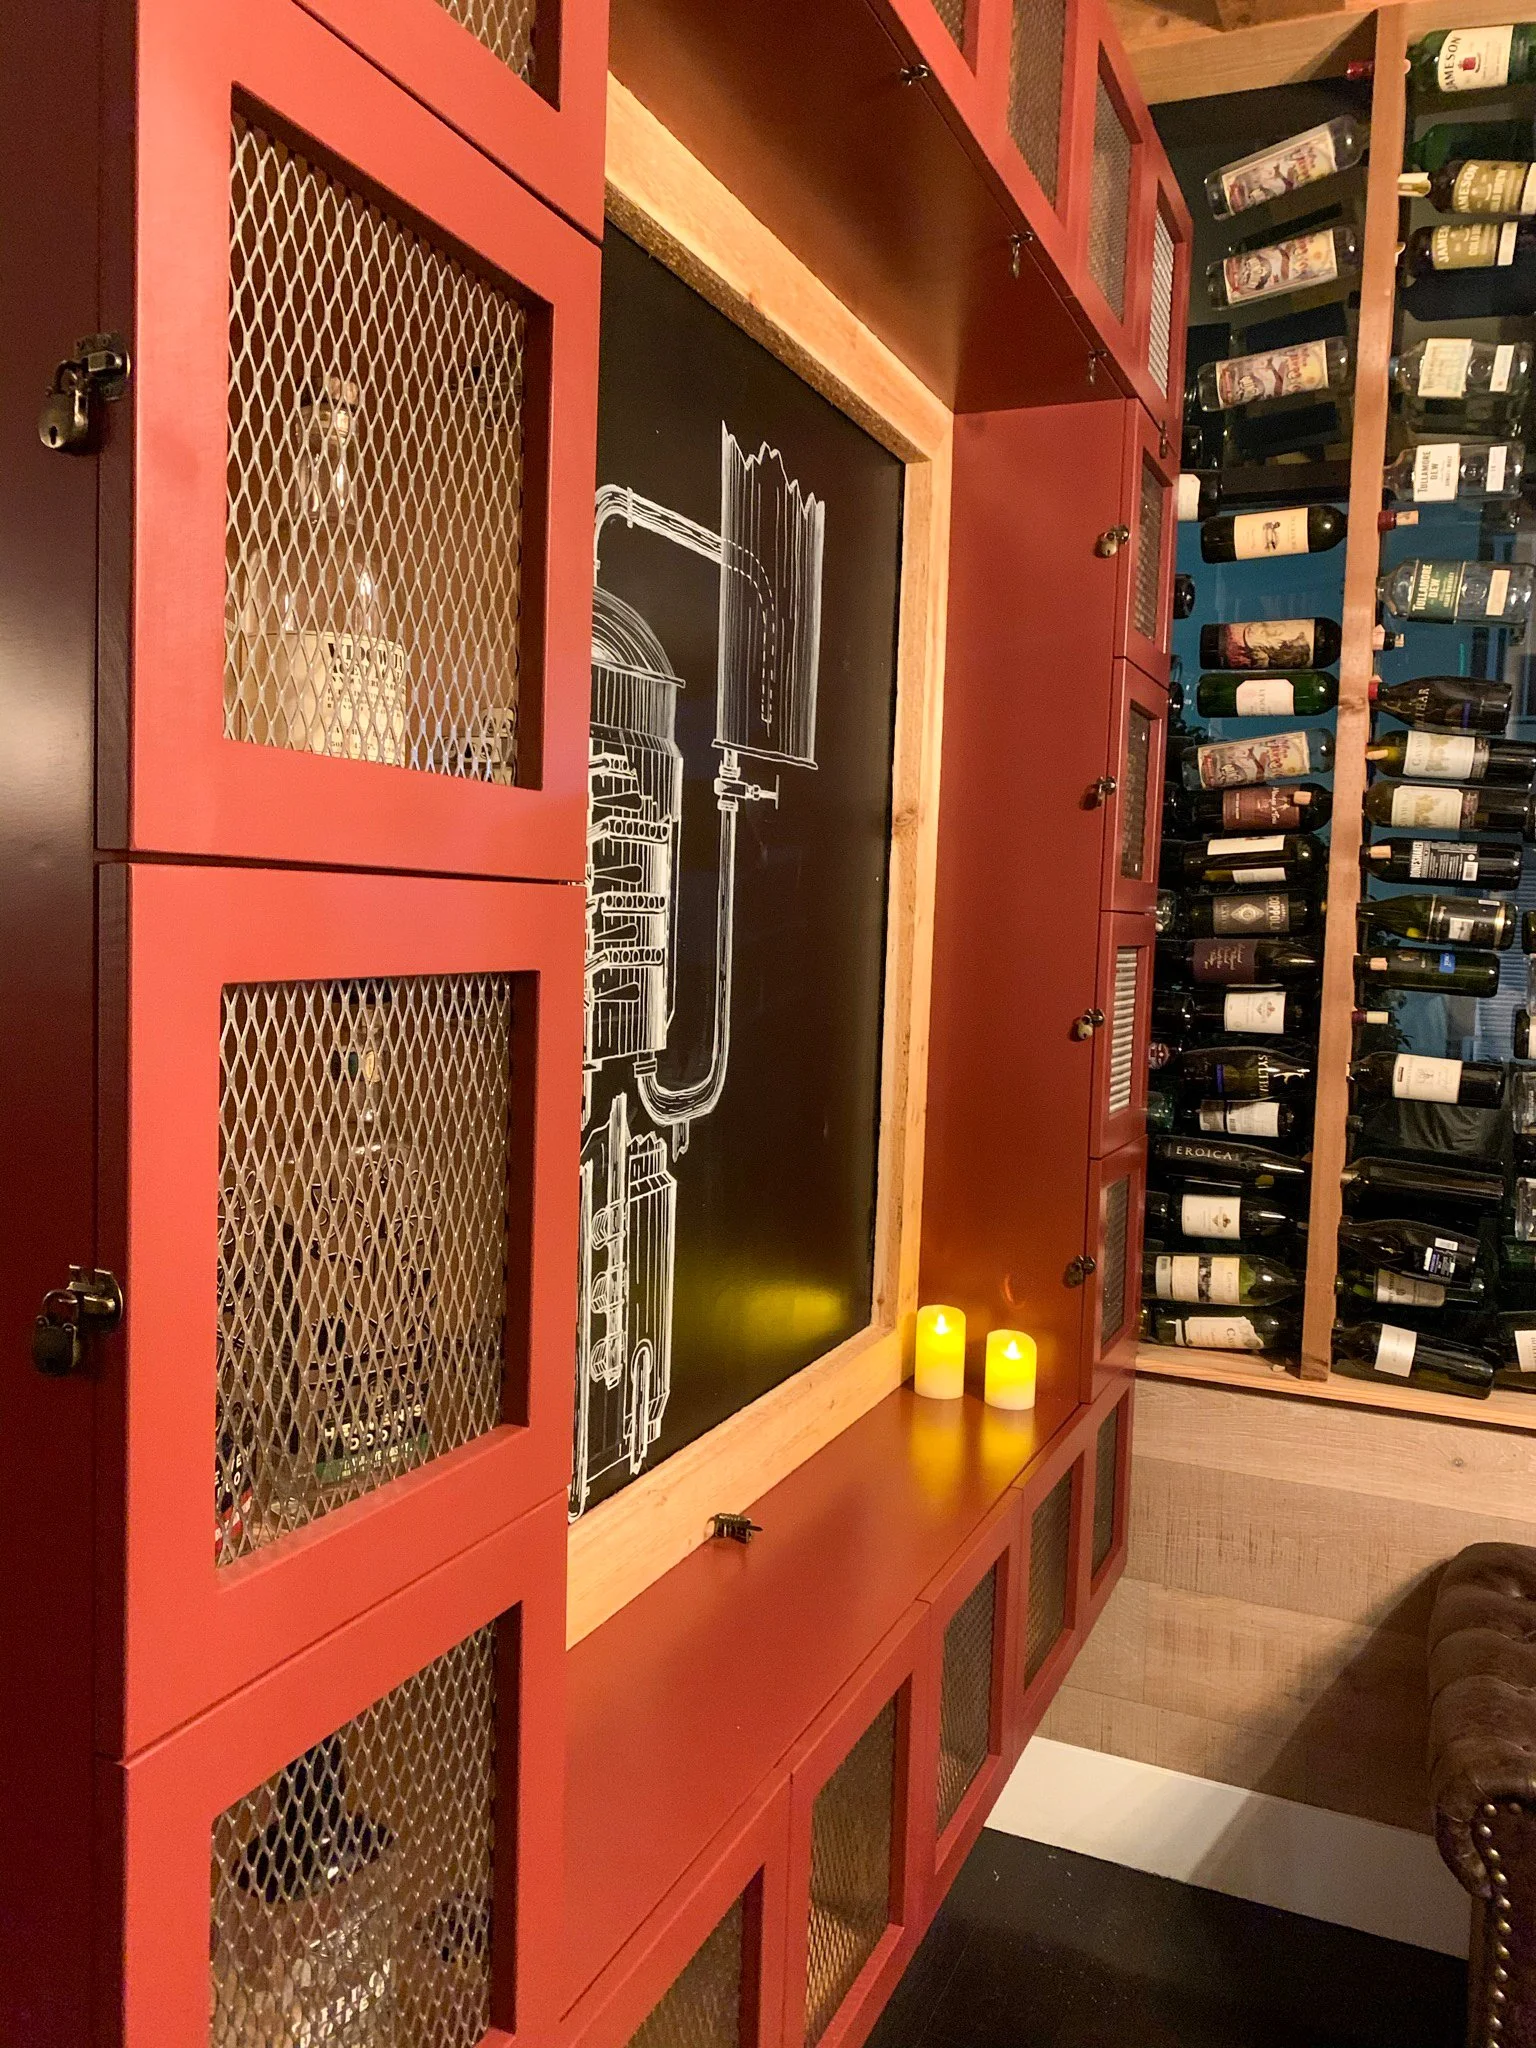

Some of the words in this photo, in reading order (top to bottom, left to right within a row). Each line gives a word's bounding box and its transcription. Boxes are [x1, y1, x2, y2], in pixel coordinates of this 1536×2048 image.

[1443, 36, 1462, 90] JAMESON
[1417, 450, 1431, 494] TULLAMORE
[1429, 462, 1439, 481] DEW
[1412, 564, 1432, 612] TULLAMORE
[1429, 578, 1441, 599] DEW
[1175, 1144, 1233, 1161] EROICA
